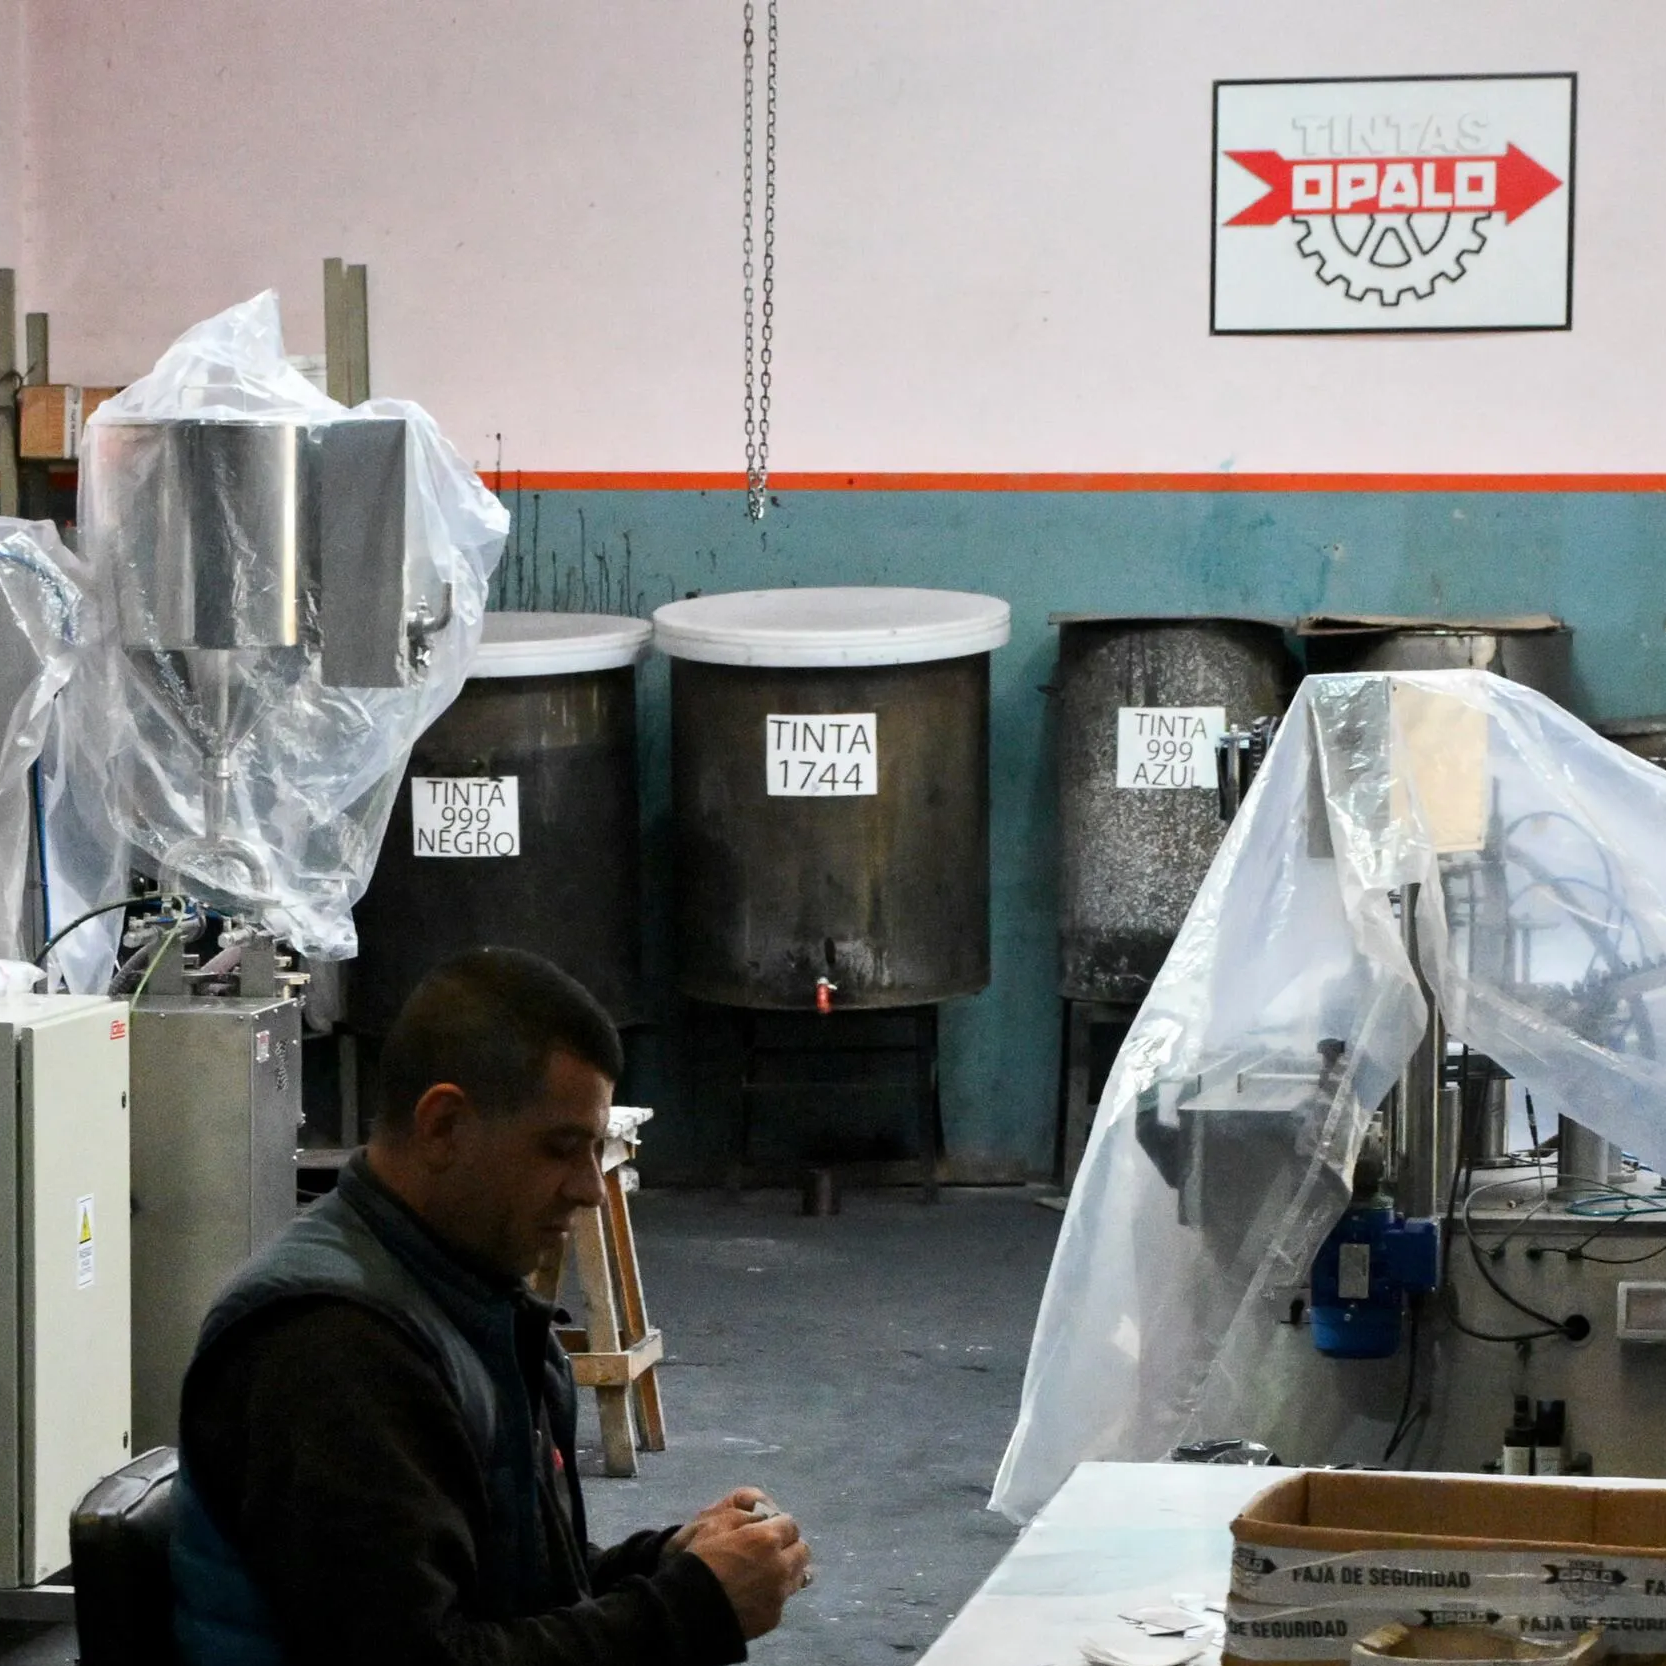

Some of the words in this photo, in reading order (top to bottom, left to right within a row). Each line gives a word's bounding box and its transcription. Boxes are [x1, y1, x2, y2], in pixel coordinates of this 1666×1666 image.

[1291, 112, 1492, 157] TINTAS
[1291, 160, 1498, 210] OPALO
[768, 718, 873, 755] TINTA
[1134, 711, 1209, 740] TINTA
[1146, 740, 1194, 763] 999
[777, 760, 864, 792] 1744
[1132, 760, 1204, 787] AZUL
[426, 780, 507, 809] TINTA
[440, 807, 492, 831] 999
[416, 827, 516, 856] NEGRO
[1292, 1566, 1334, 1584] FAJA
[1340, 1566, 1363, 1585] DE
[1369, 1566, 1471, 1589] SEGURIDAD
[1251, 1618, 1349, 1639] SEGURIDAD
[1518, 1615, 1566, 1632] FAJA
